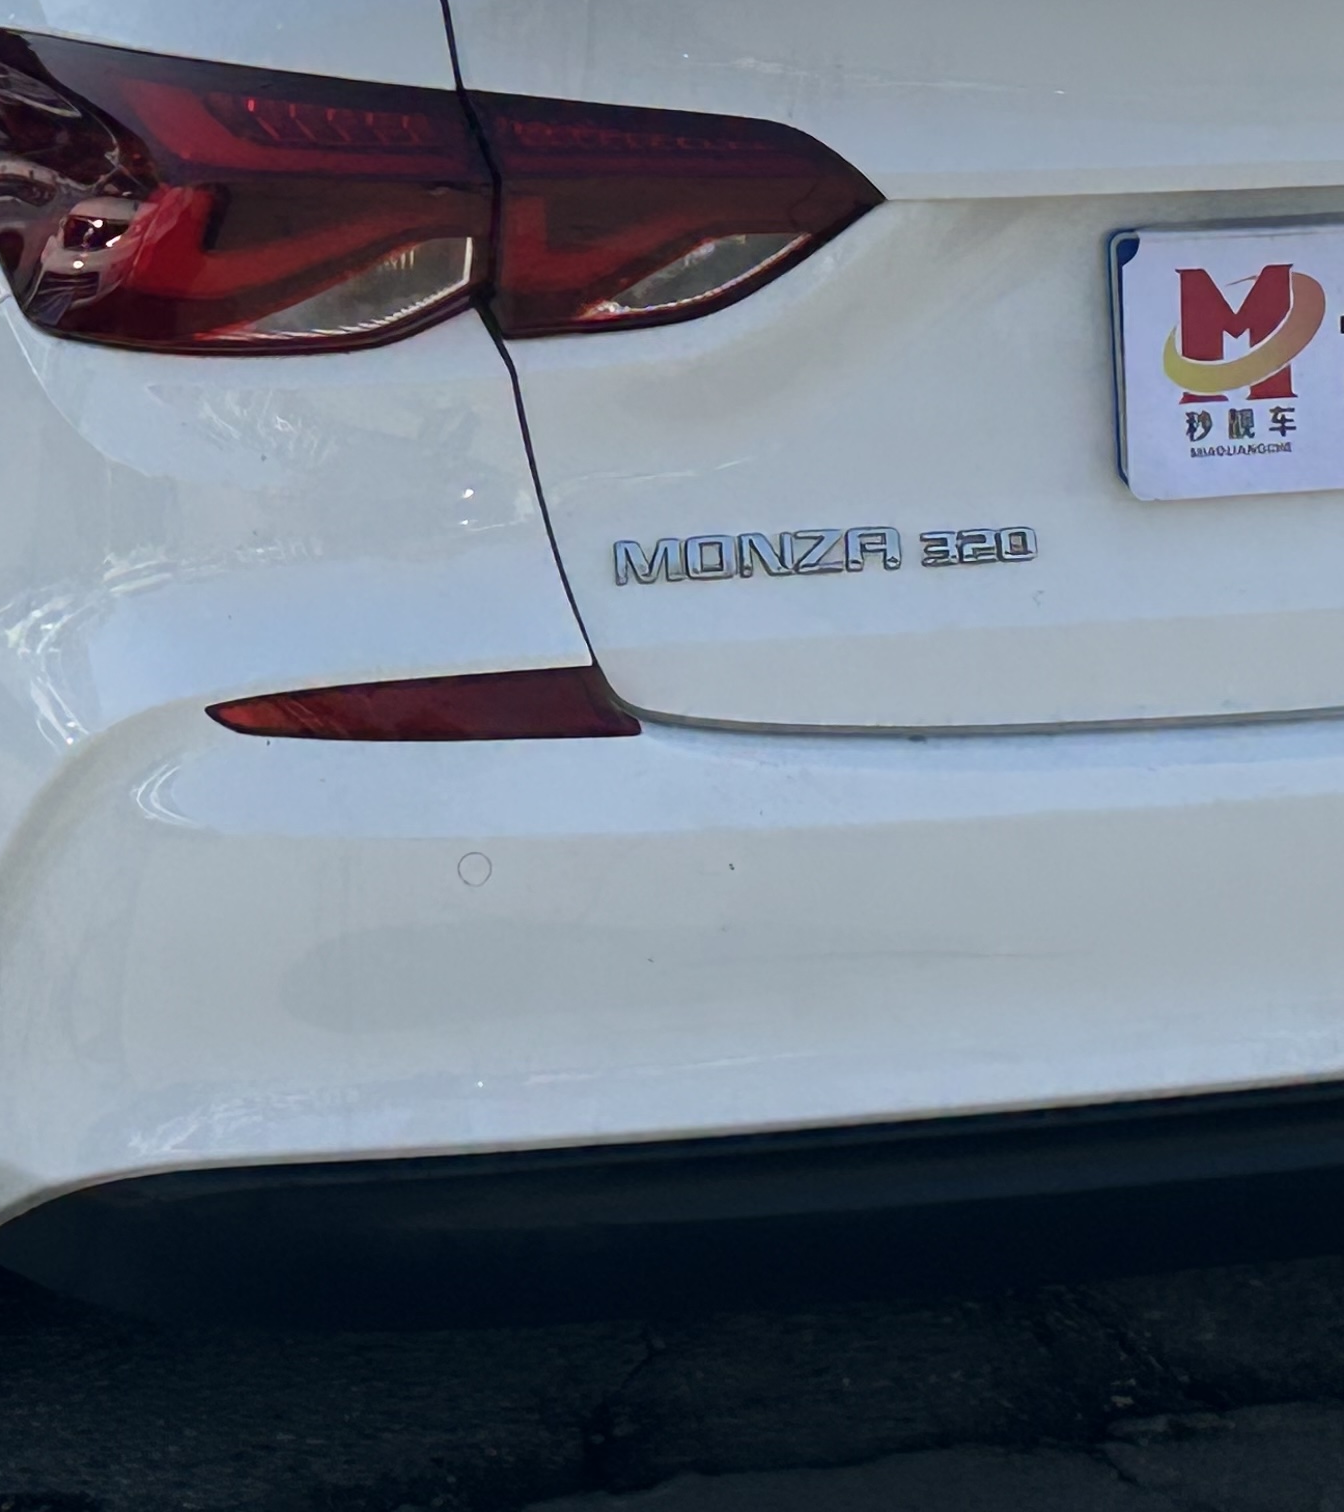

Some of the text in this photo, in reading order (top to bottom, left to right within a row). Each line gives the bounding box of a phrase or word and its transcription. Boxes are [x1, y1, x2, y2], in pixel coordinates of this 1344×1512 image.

[1175, 263, 1298, 404] M
[614, 526, 1038, 586] MONZA 320
